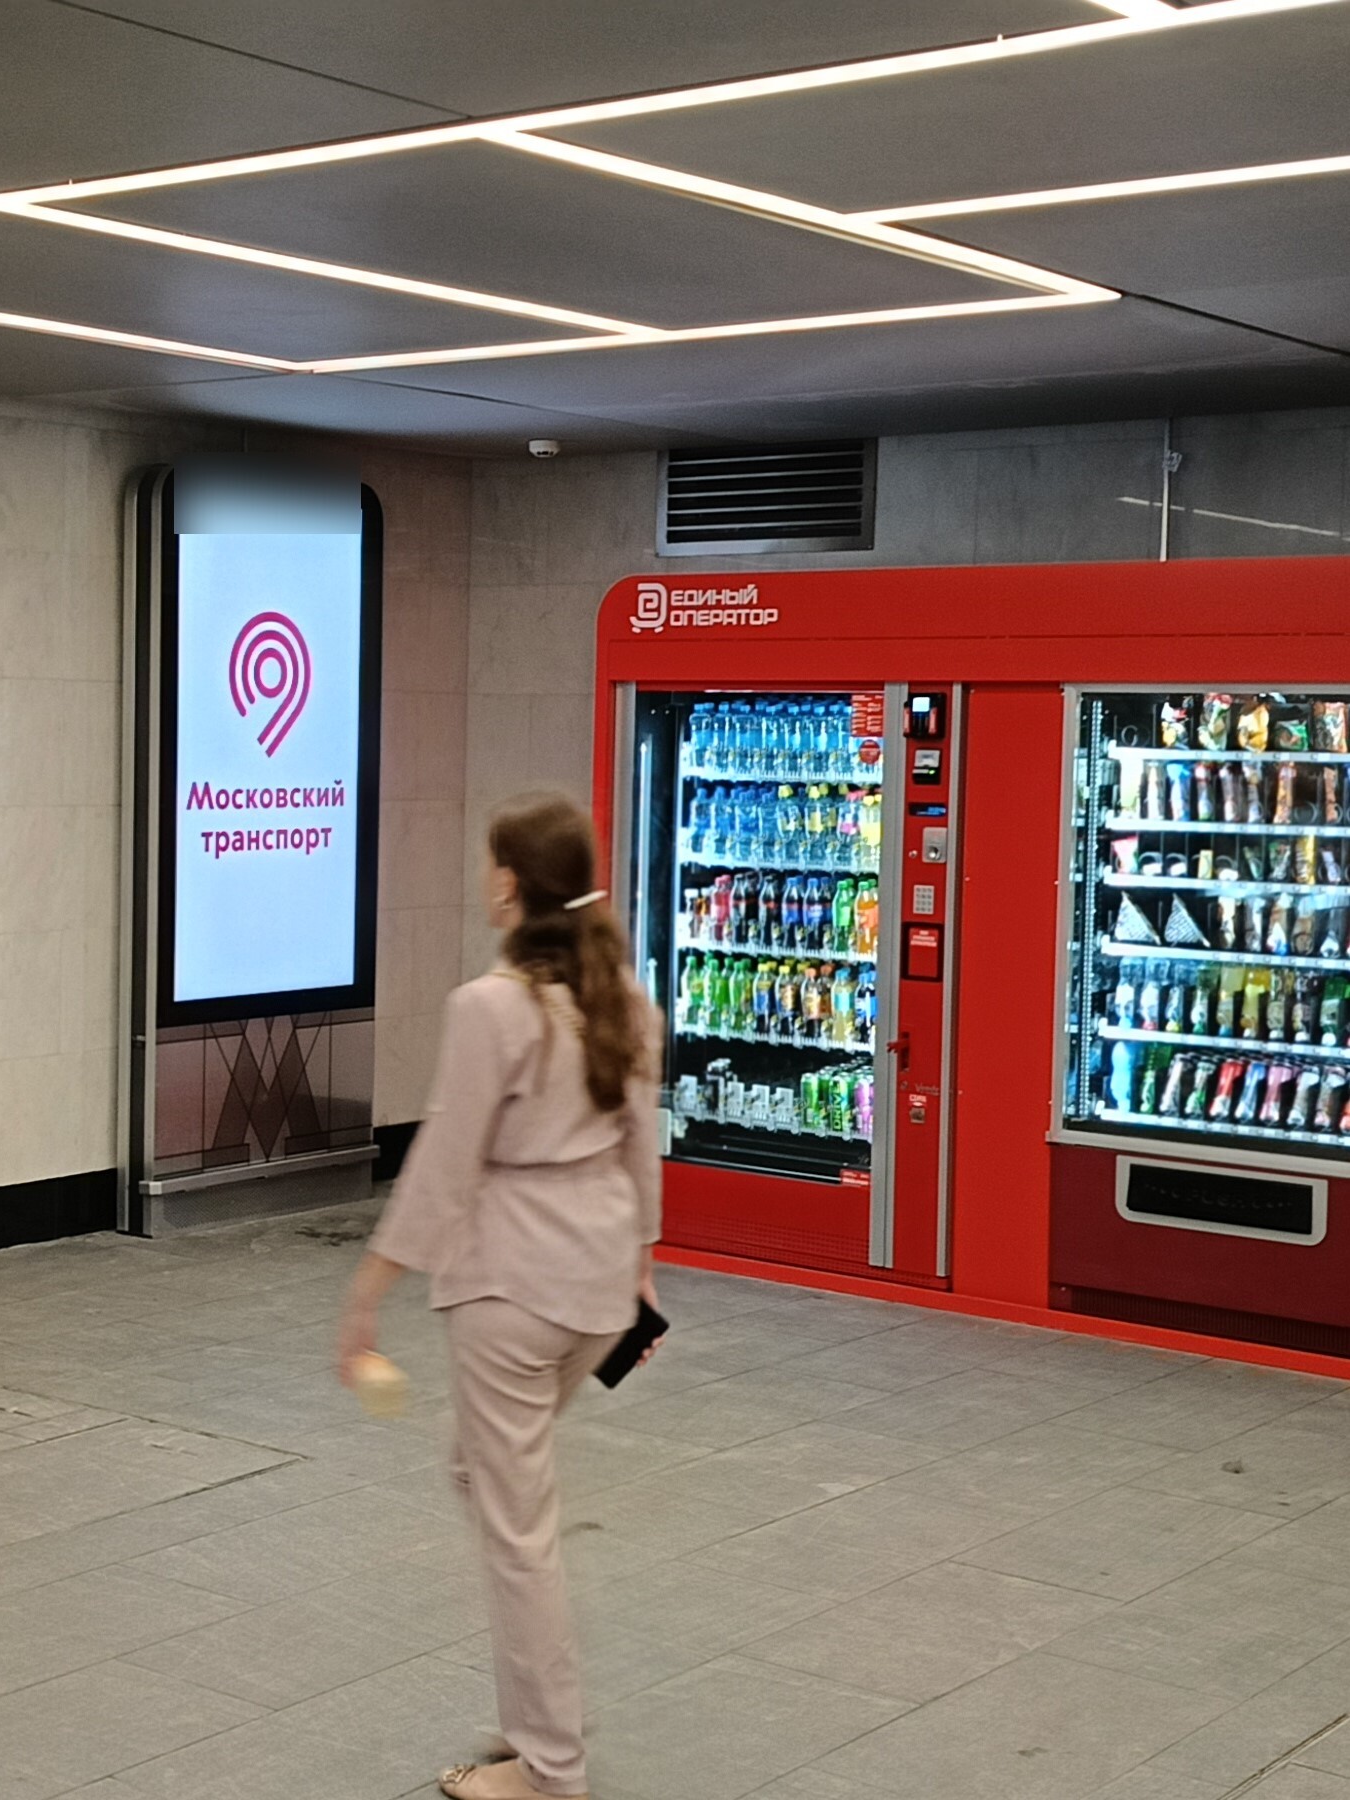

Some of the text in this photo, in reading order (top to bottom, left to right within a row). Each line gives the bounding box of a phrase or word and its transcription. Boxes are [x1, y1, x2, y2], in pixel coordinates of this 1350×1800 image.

[670, 584, 759, 606] ЕДИНЫЙ
[669, 608, 779, 627] ОПЕРАТОР
[186, 779, 345, 811] Московский
[201, 827, 332, 860] транспорт
